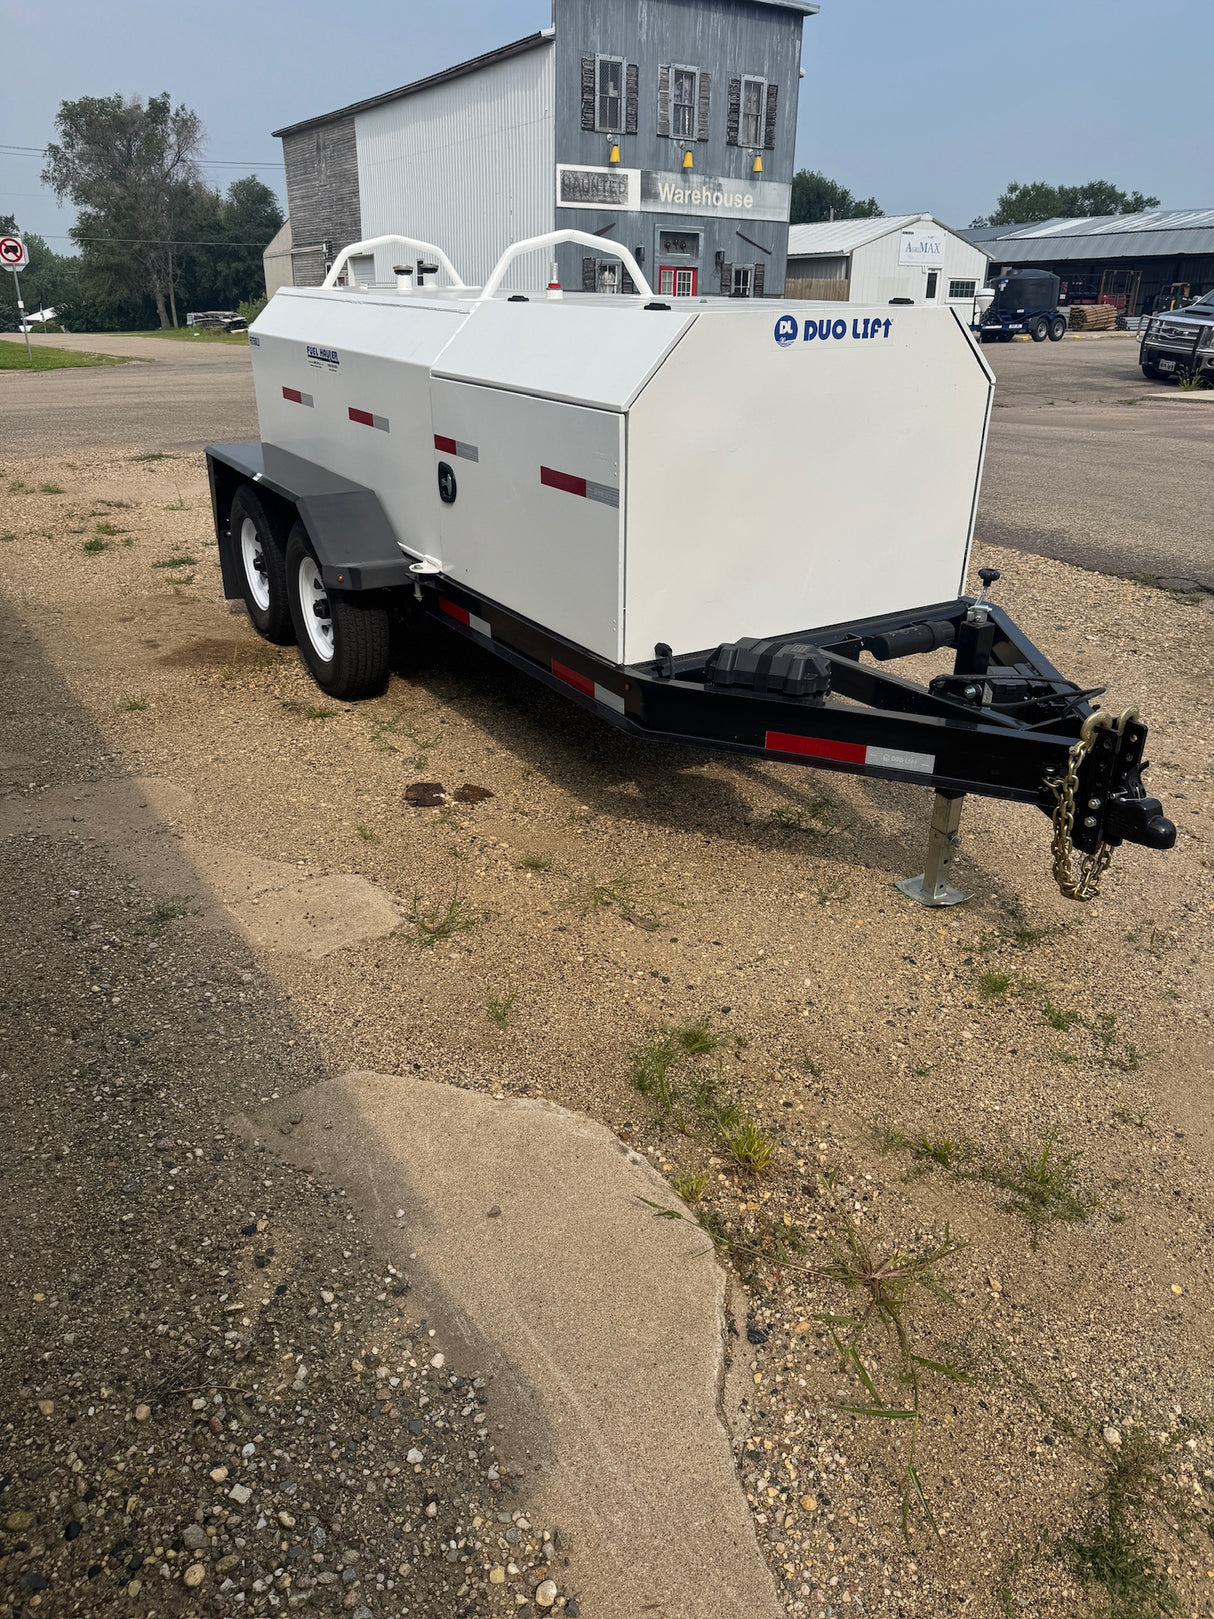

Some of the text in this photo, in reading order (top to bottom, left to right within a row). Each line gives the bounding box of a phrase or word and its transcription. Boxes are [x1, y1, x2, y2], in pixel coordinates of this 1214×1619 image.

[658, 182, 753, 208] Warehouse
[803, 319, 847, 341] DUO
[306, 345, 338, 360] FUEL HAULER
